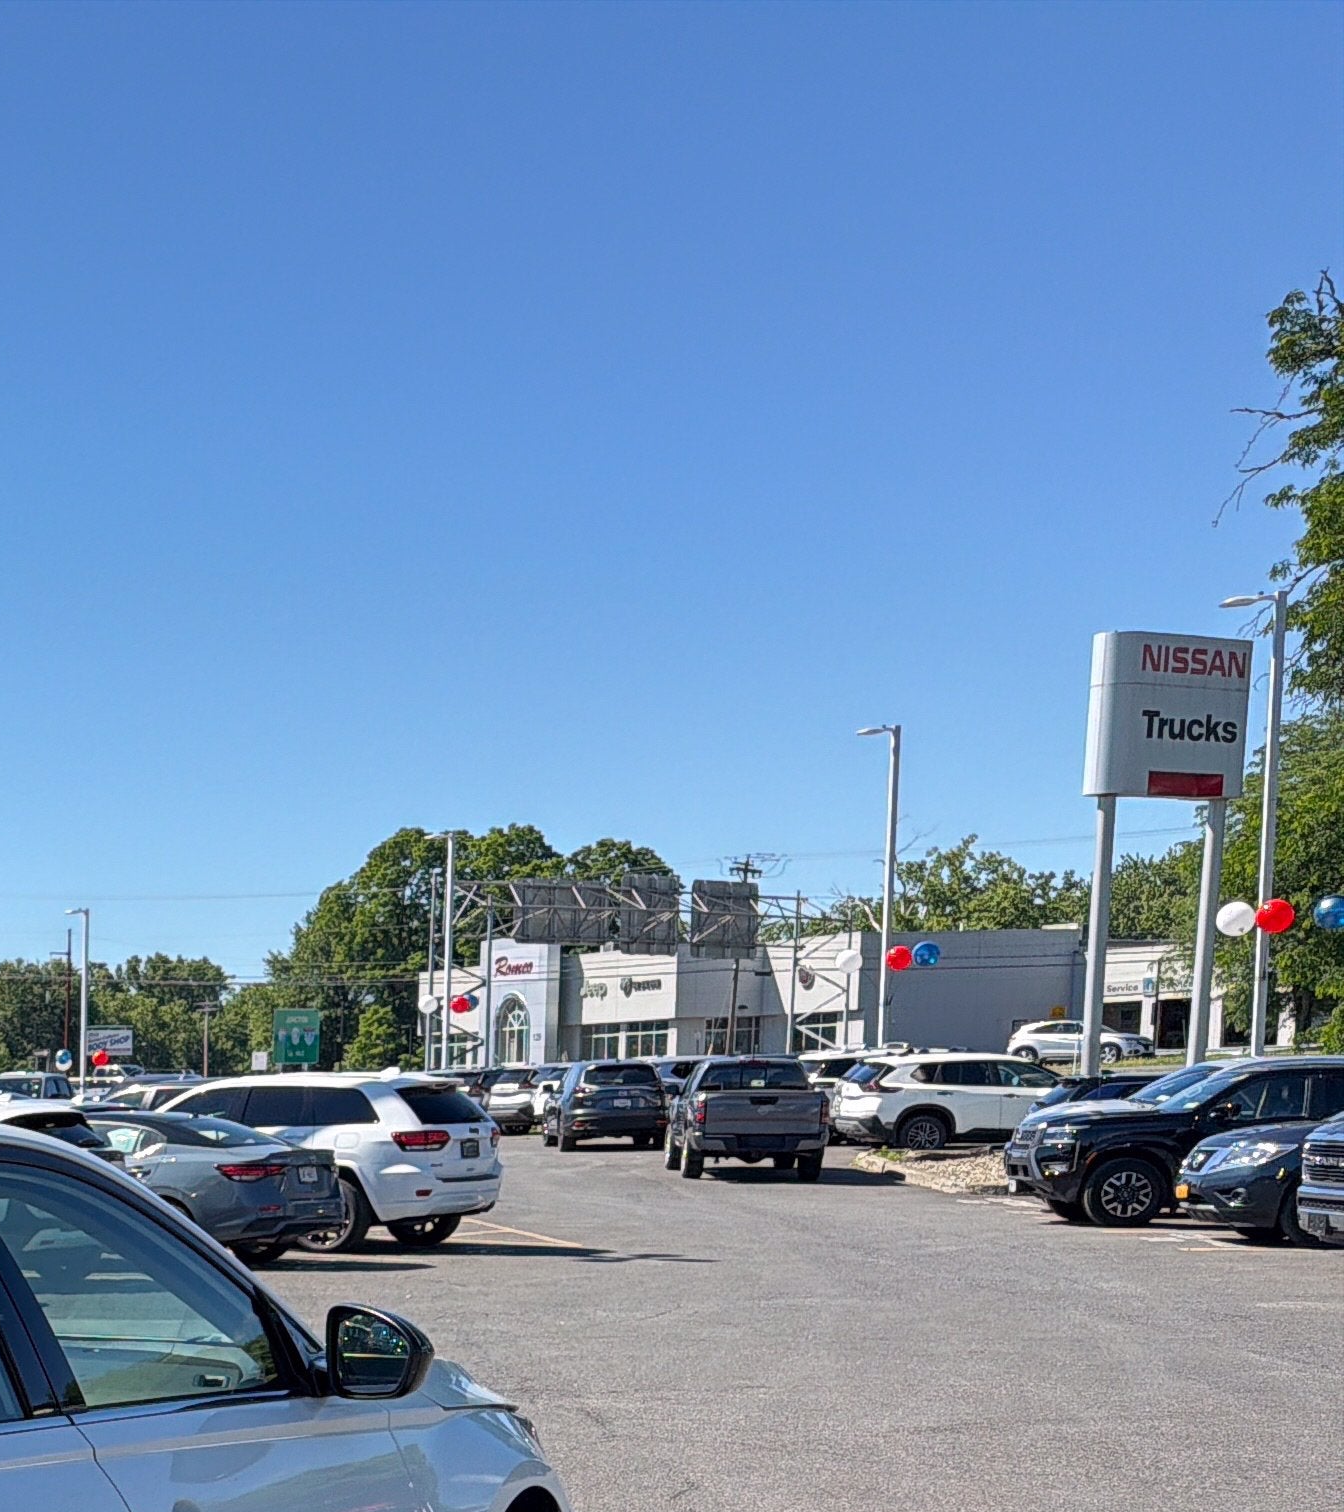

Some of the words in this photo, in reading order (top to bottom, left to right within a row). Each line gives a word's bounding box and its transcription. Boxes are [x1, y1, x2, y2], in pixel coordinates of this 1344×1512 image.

[1142, 644, 1247, 678] NISSAN
[1142, 710, 1238, 743] Trucks
[494, 956, 534, 977] Romeo
